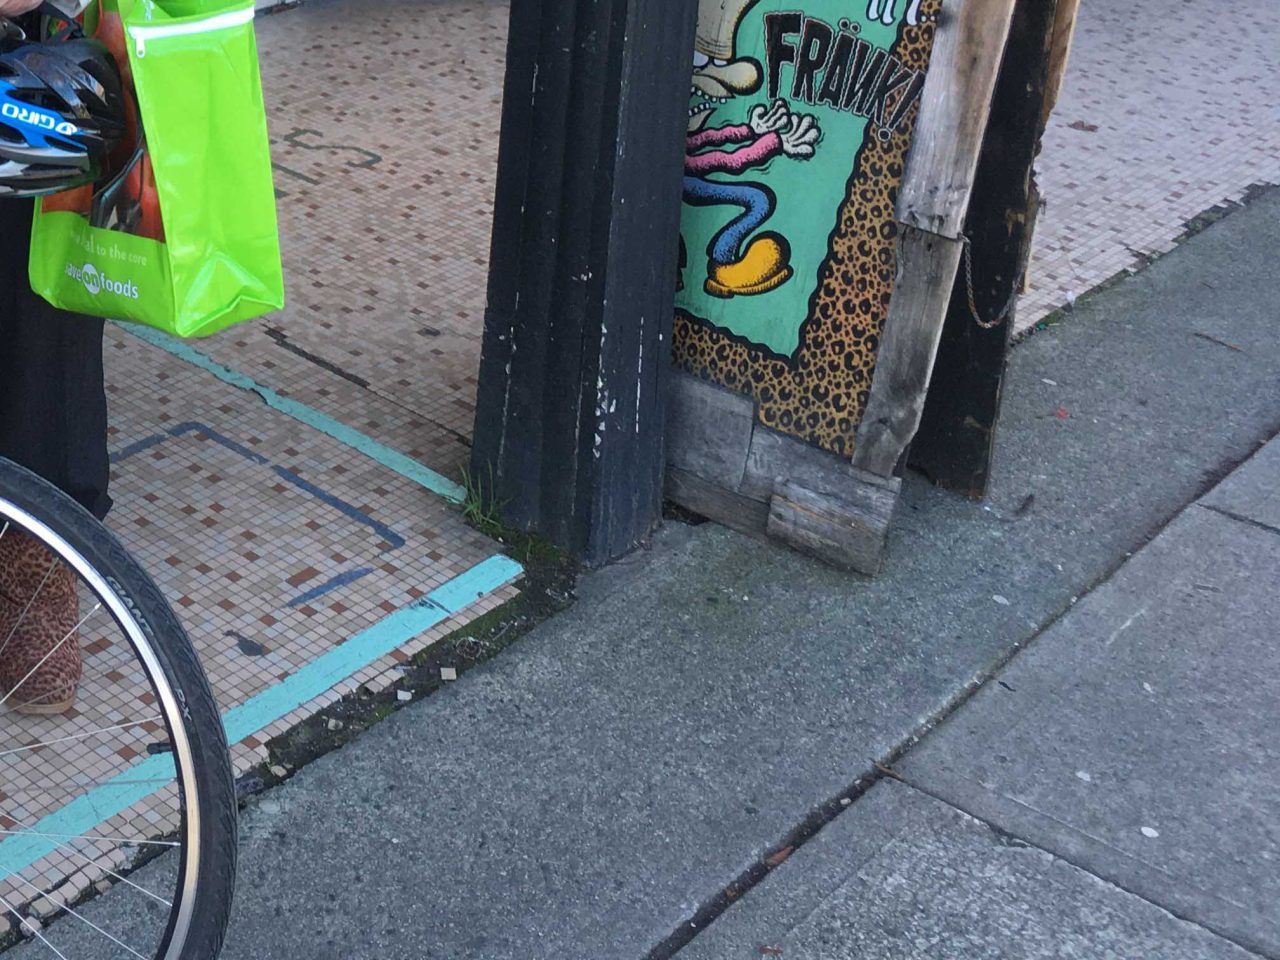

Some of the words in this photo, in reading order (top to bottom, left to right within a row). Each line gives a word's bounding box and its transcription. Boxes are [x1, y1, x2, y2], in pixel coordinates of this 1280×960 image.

[1, 102, 55, 130] GIRO
[96, 244, 106, 256] to
[109, 243, 127, 261] the
[128, 252, 148, 267] core
[100, 272, 139, 300] foods
[106, 576, 155, 637] GIANT
